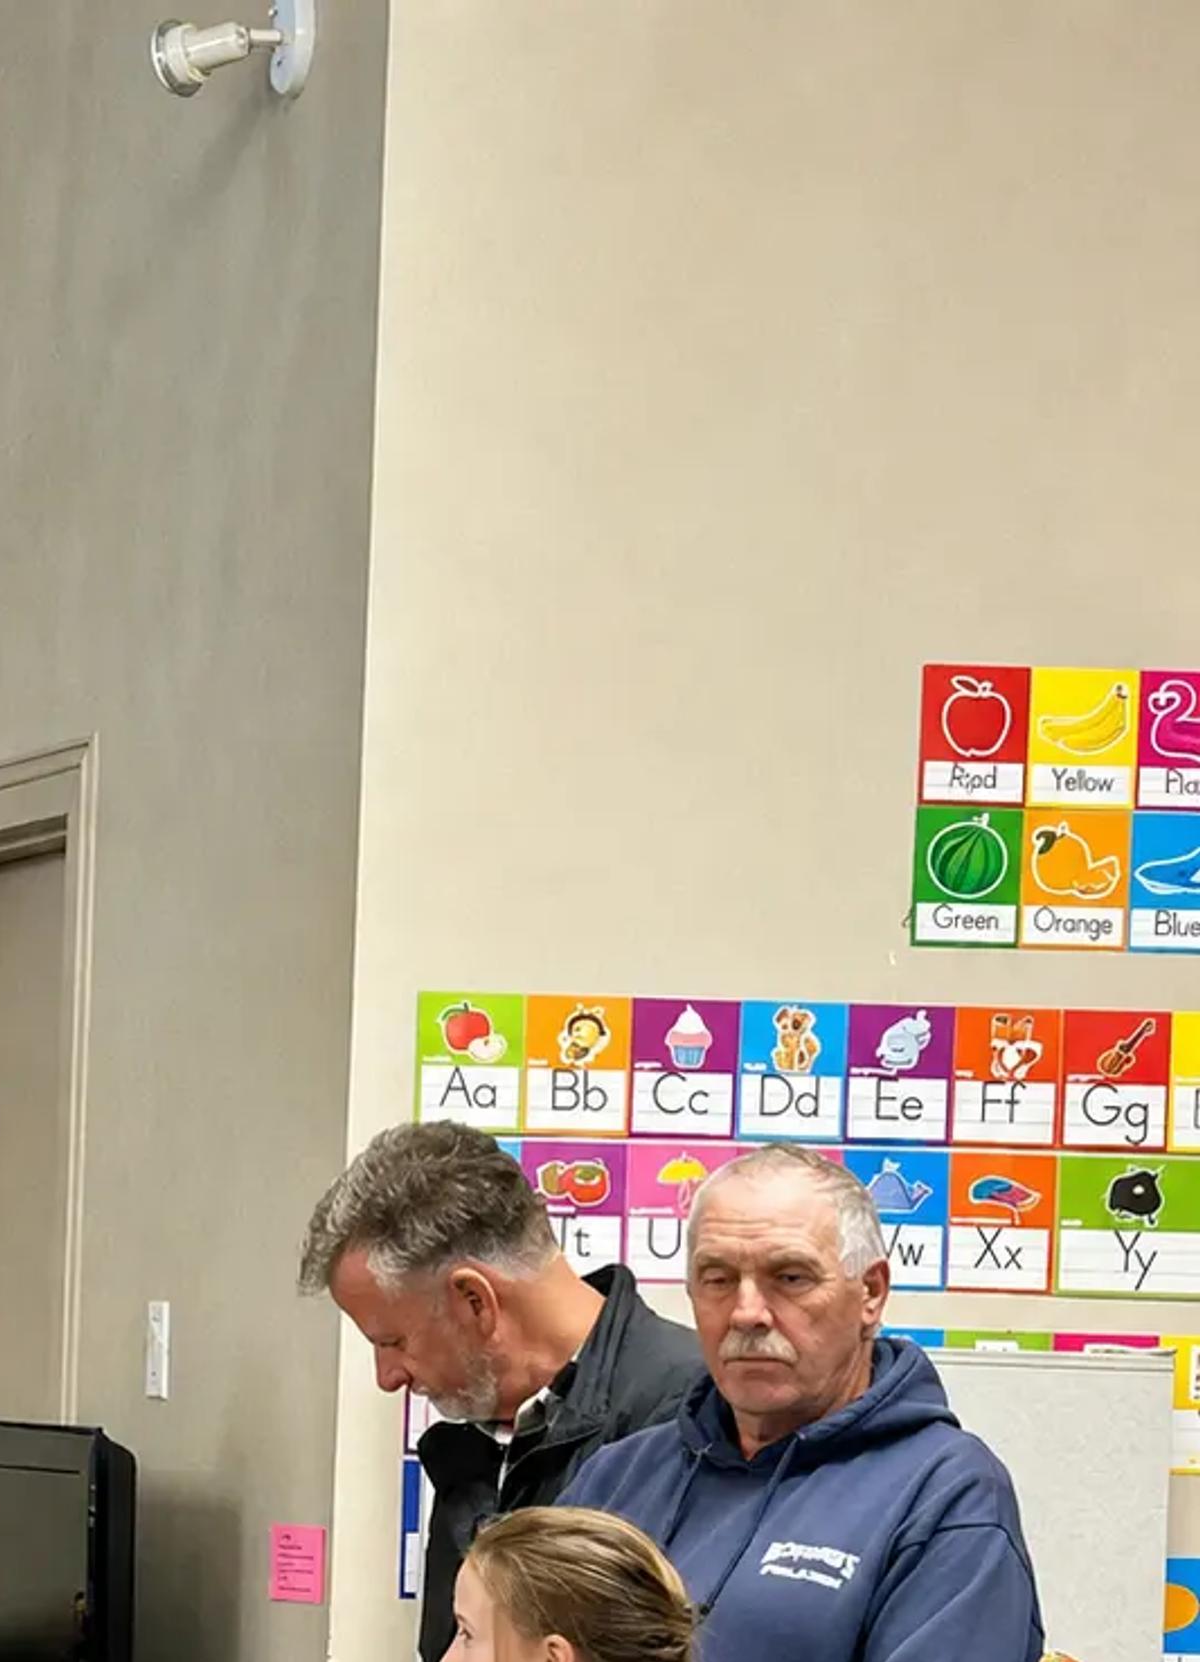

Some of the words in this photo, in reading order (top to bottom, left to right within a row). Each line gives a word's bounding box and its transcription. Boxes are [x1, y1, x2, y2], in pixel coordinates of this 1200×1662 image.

[1051, 767, 1115, 792] Yellow
[932, 903, 999, 929] Green
[1033, 905, 1113, 941] Orange
[1155, 909, 1200, 937] Blue
[439, 1066, 497, 1108] Aa
[551, 1069, 608, 1111] Bb
[653, 1072, 709, 1115] Cc
[760, 1074, 819, 1117] Dd
[875, 1078, 923, 1120] Ee
[981, 1080, 1026, 1123] Ff
[1082, 1083, 1149, 1145] Gg
[974, 1226, 1022, 1270] Xx
[1114, 1230, 1158, 1291] Yy
